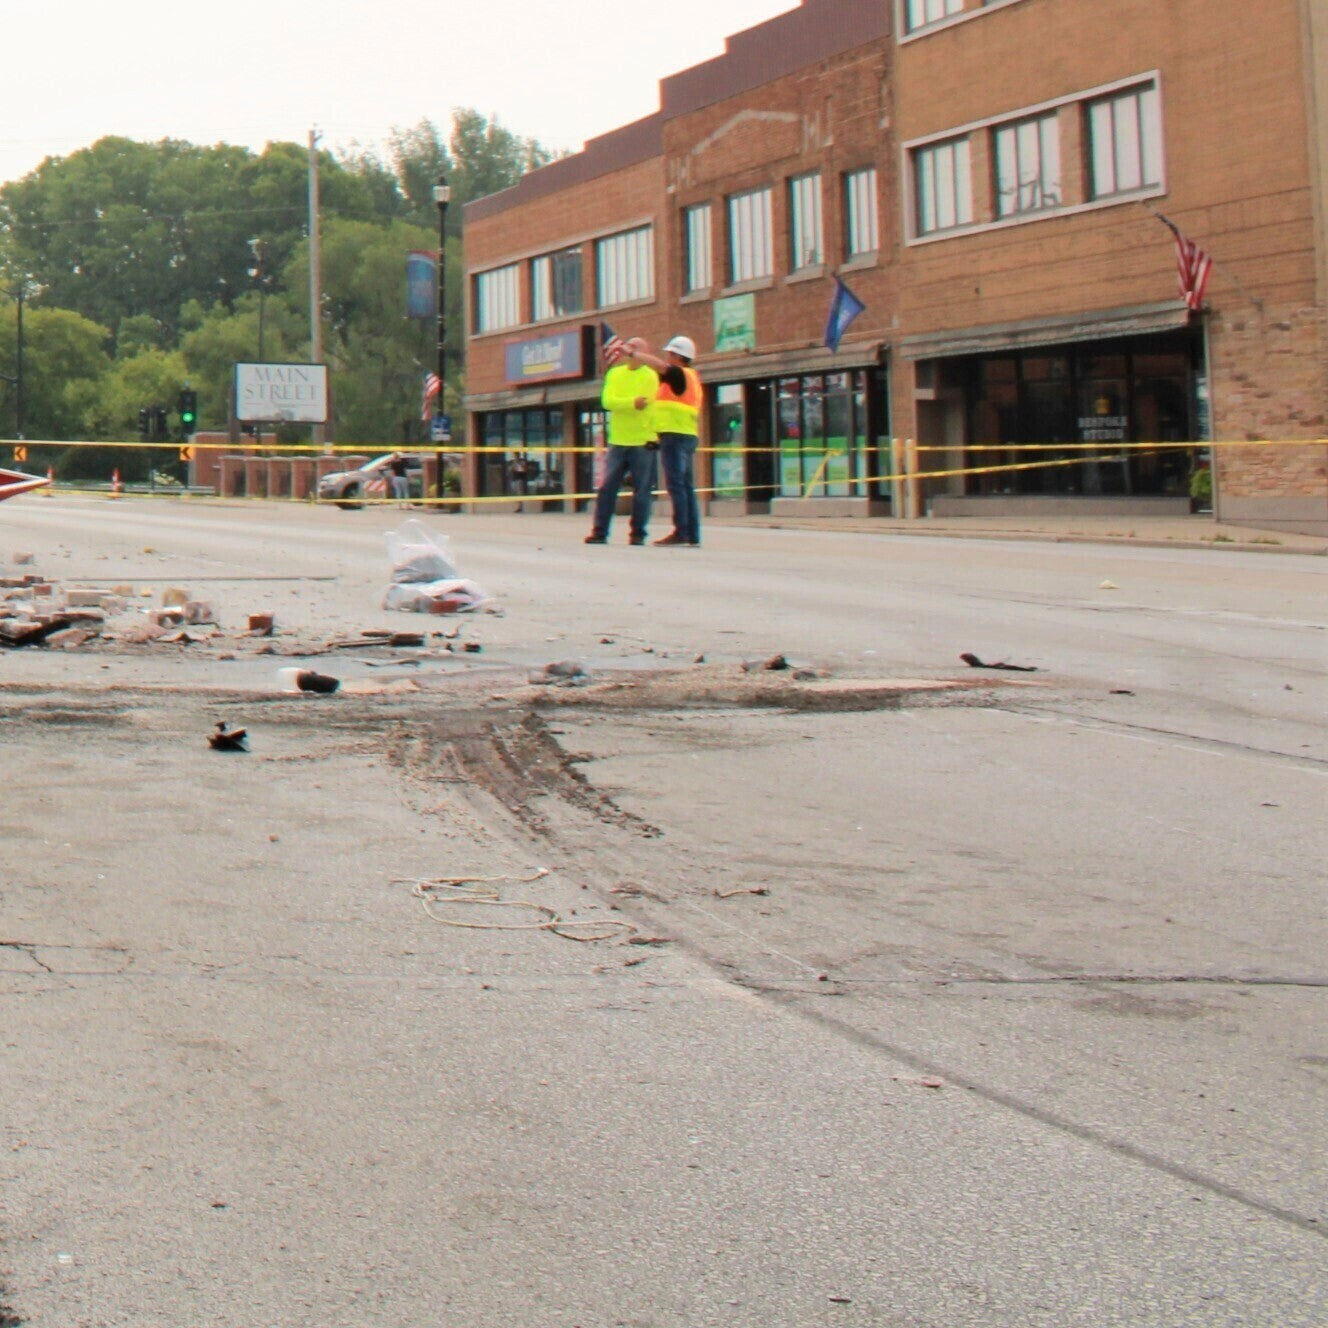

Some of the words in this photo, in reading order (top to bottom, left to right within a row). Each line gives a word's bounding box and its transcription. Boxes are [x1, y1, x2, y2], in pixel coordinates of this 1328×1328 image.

[253, 367, 309, 382] MAIN
[244, 383, 320, 400] STREET
[1084, 429, 1124, 440] STUDIO
